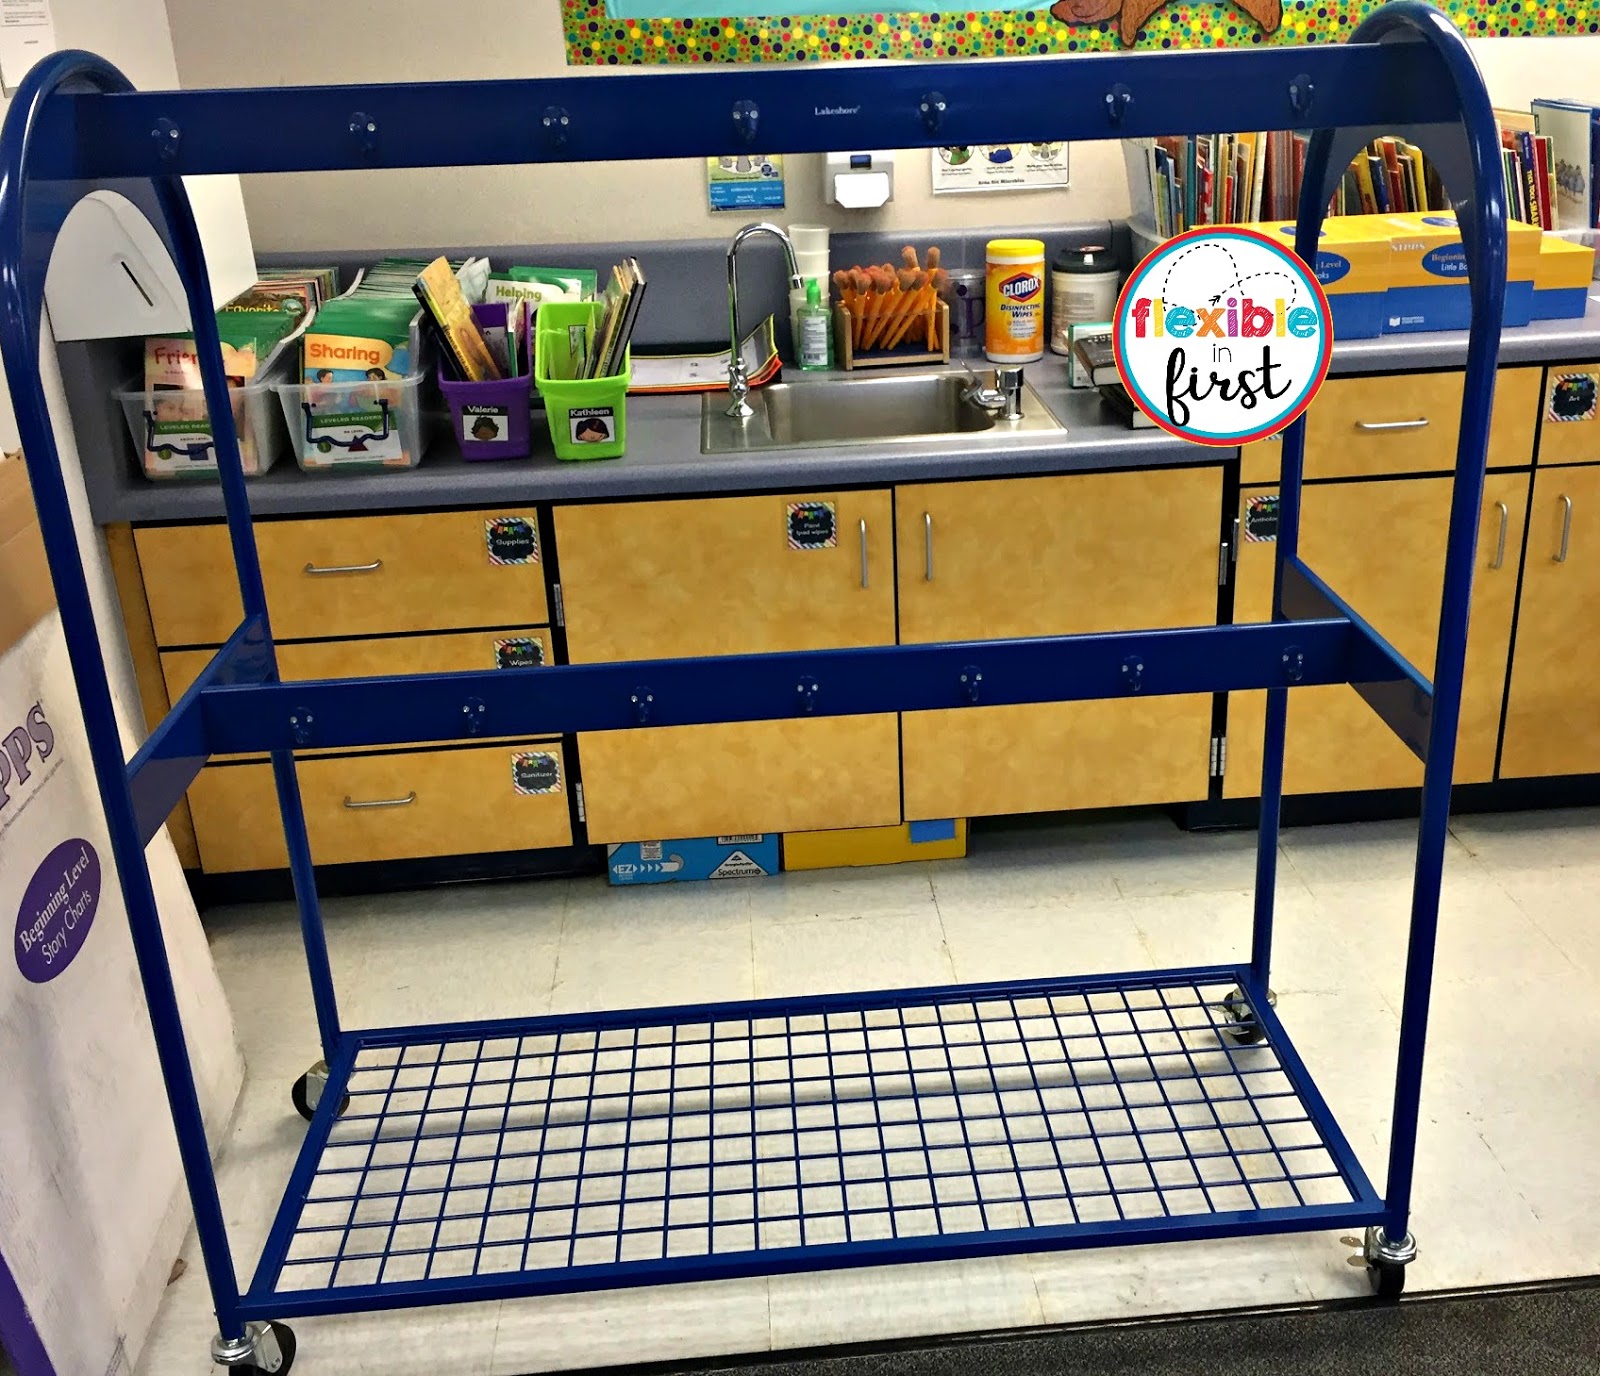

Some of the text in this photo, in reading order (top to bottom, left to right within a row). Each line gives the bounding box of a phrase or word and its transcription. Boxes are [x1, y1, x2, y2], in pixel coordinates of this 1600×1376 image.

[814, 106, 859, 116] Lakeshore
[1003, 278, 1040, 298] CLOROX
[496, 285, 542, 301] Helping
[1012, 310, 1033, 318] WIPES
[310, 343, 381, 365] Sharing
[468, 405, 499, 413] Valerie
[570, 408, 610, 417] Kathleen
[496, 538, 530, 546] Supplies
[509, 659, 533, 667] Wipes
[717, 868, 755, 877] Spectrum
[19, 884, 70, 954] Beginning
[64, 846, 91, 890] Level
[41, 889, 93, 965] Story Charts
